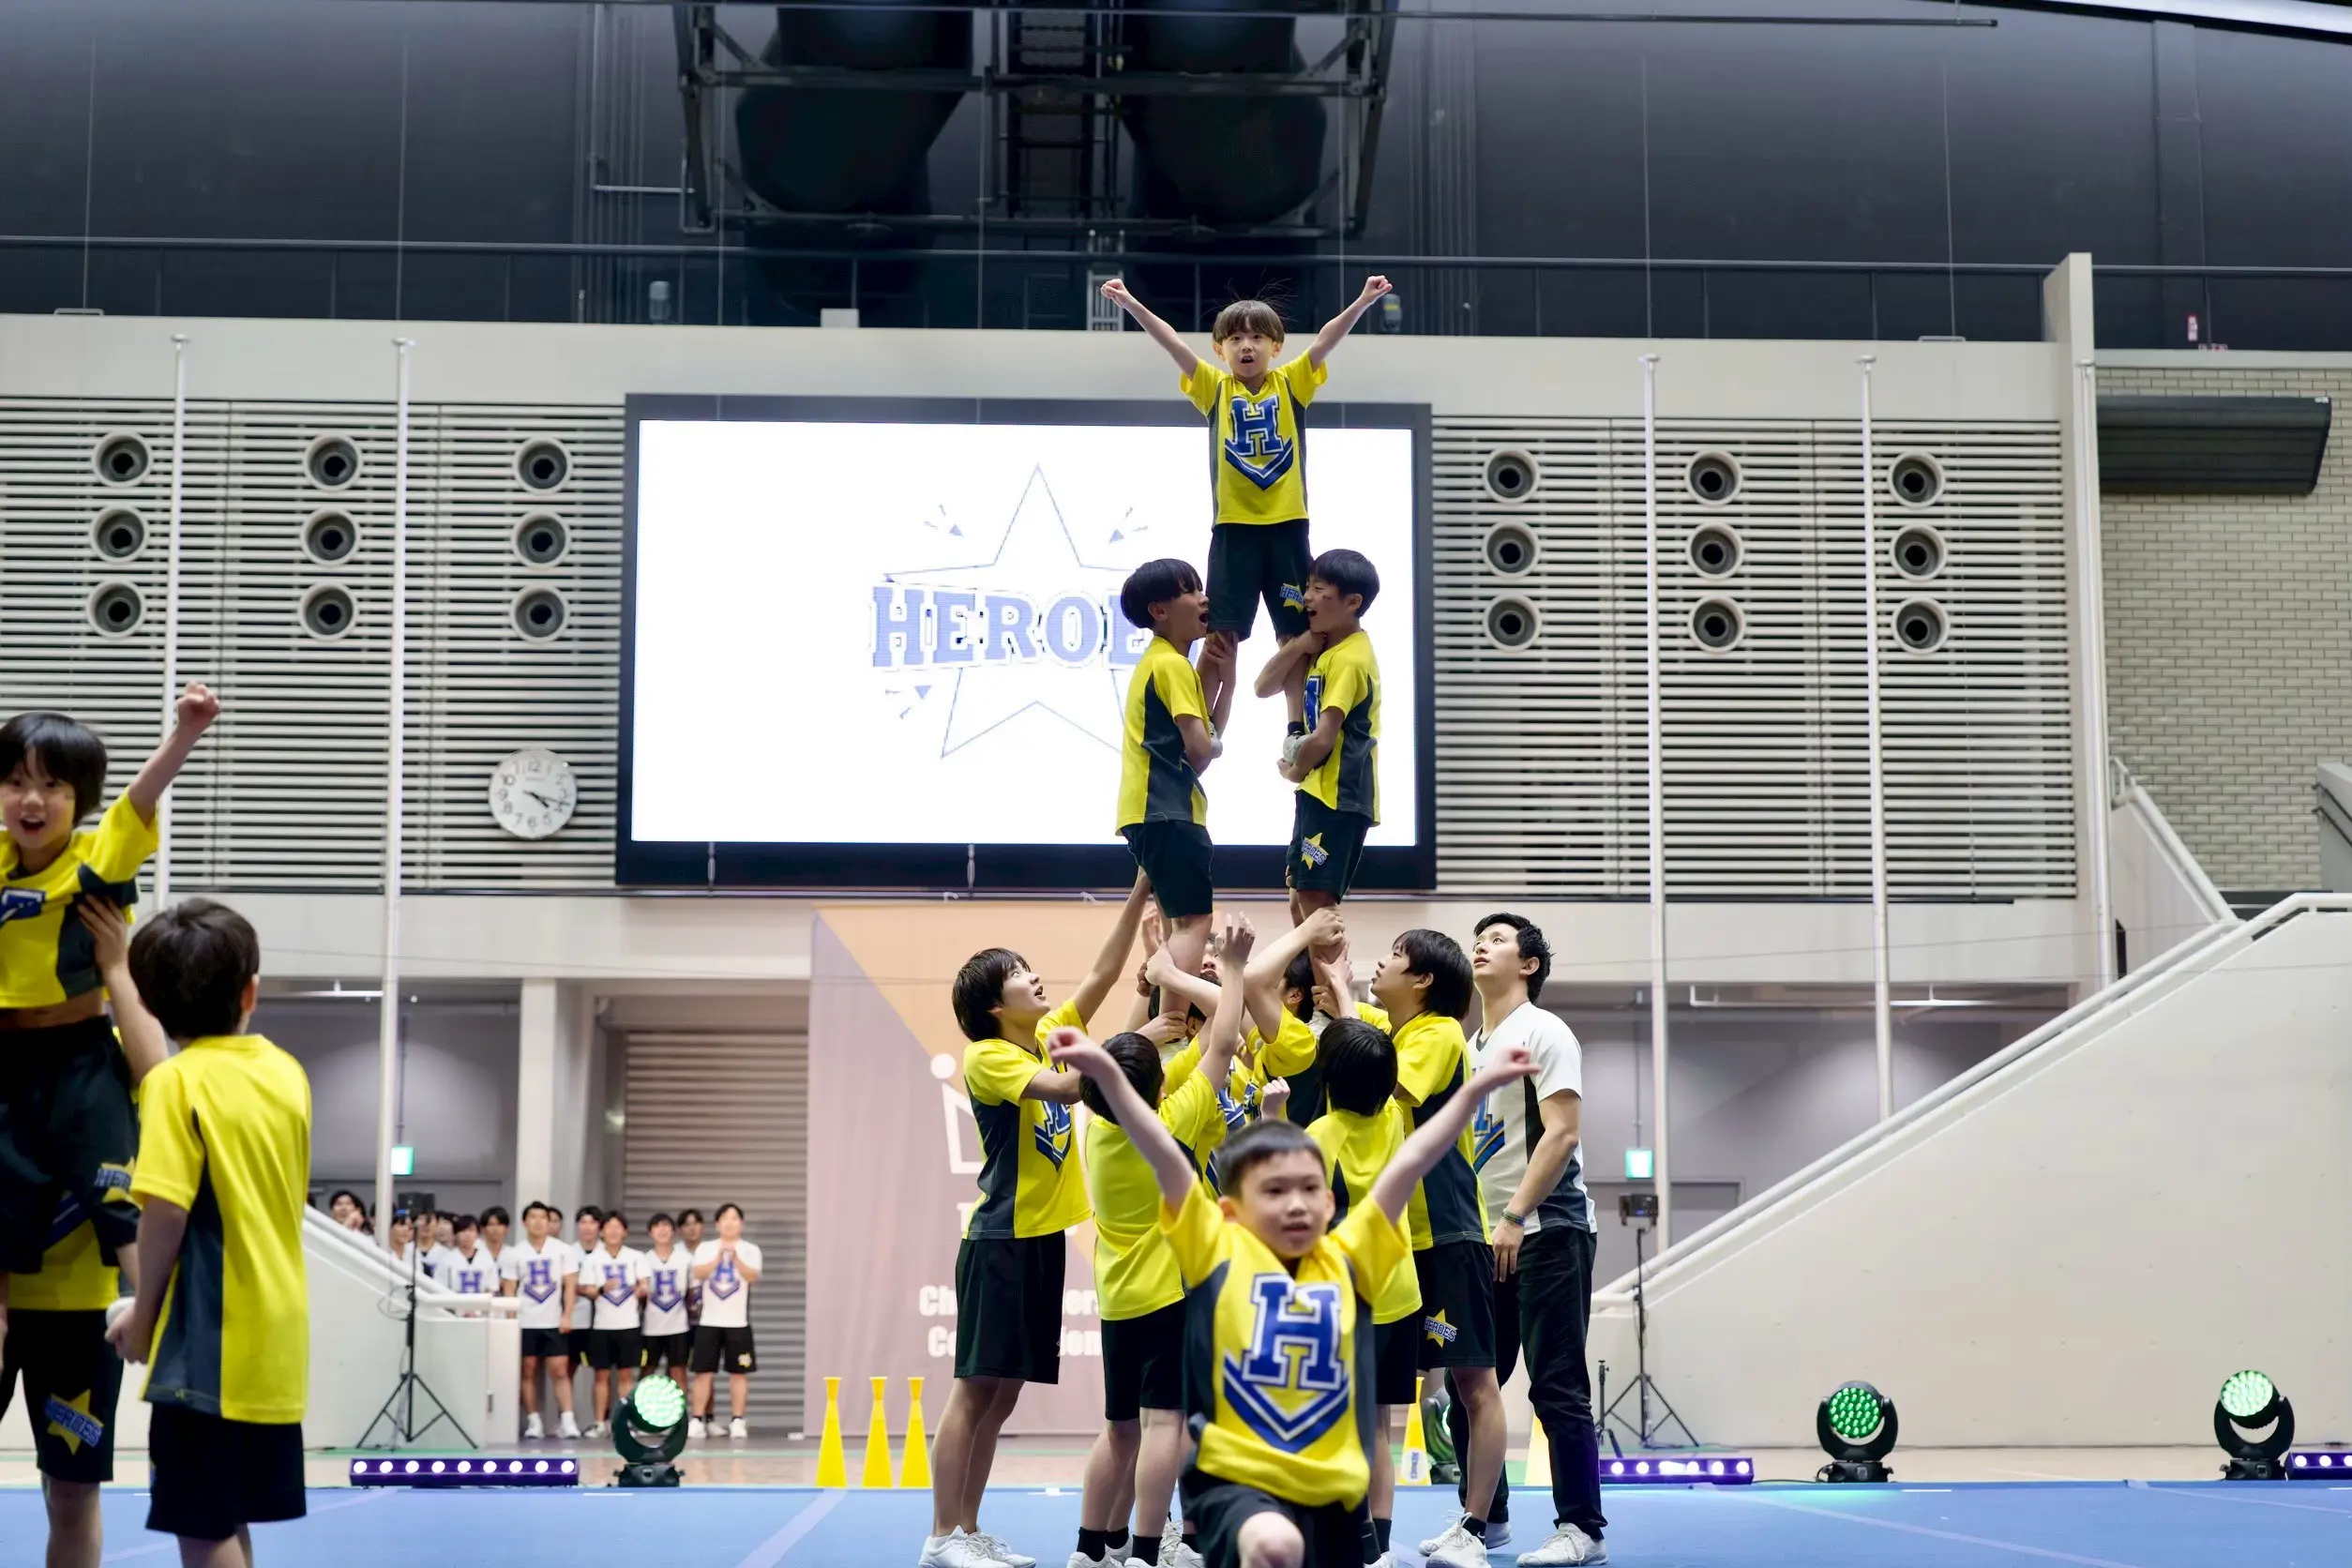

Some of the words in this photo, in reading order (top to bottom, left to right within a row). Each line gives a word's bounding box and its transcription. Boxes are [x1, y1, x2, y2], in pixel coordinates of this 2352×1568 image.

[1230, 394, 1284, 458] H
[872, 585, 1199, 668] HEROE
[1242, 1273, 1344, 1390] H
